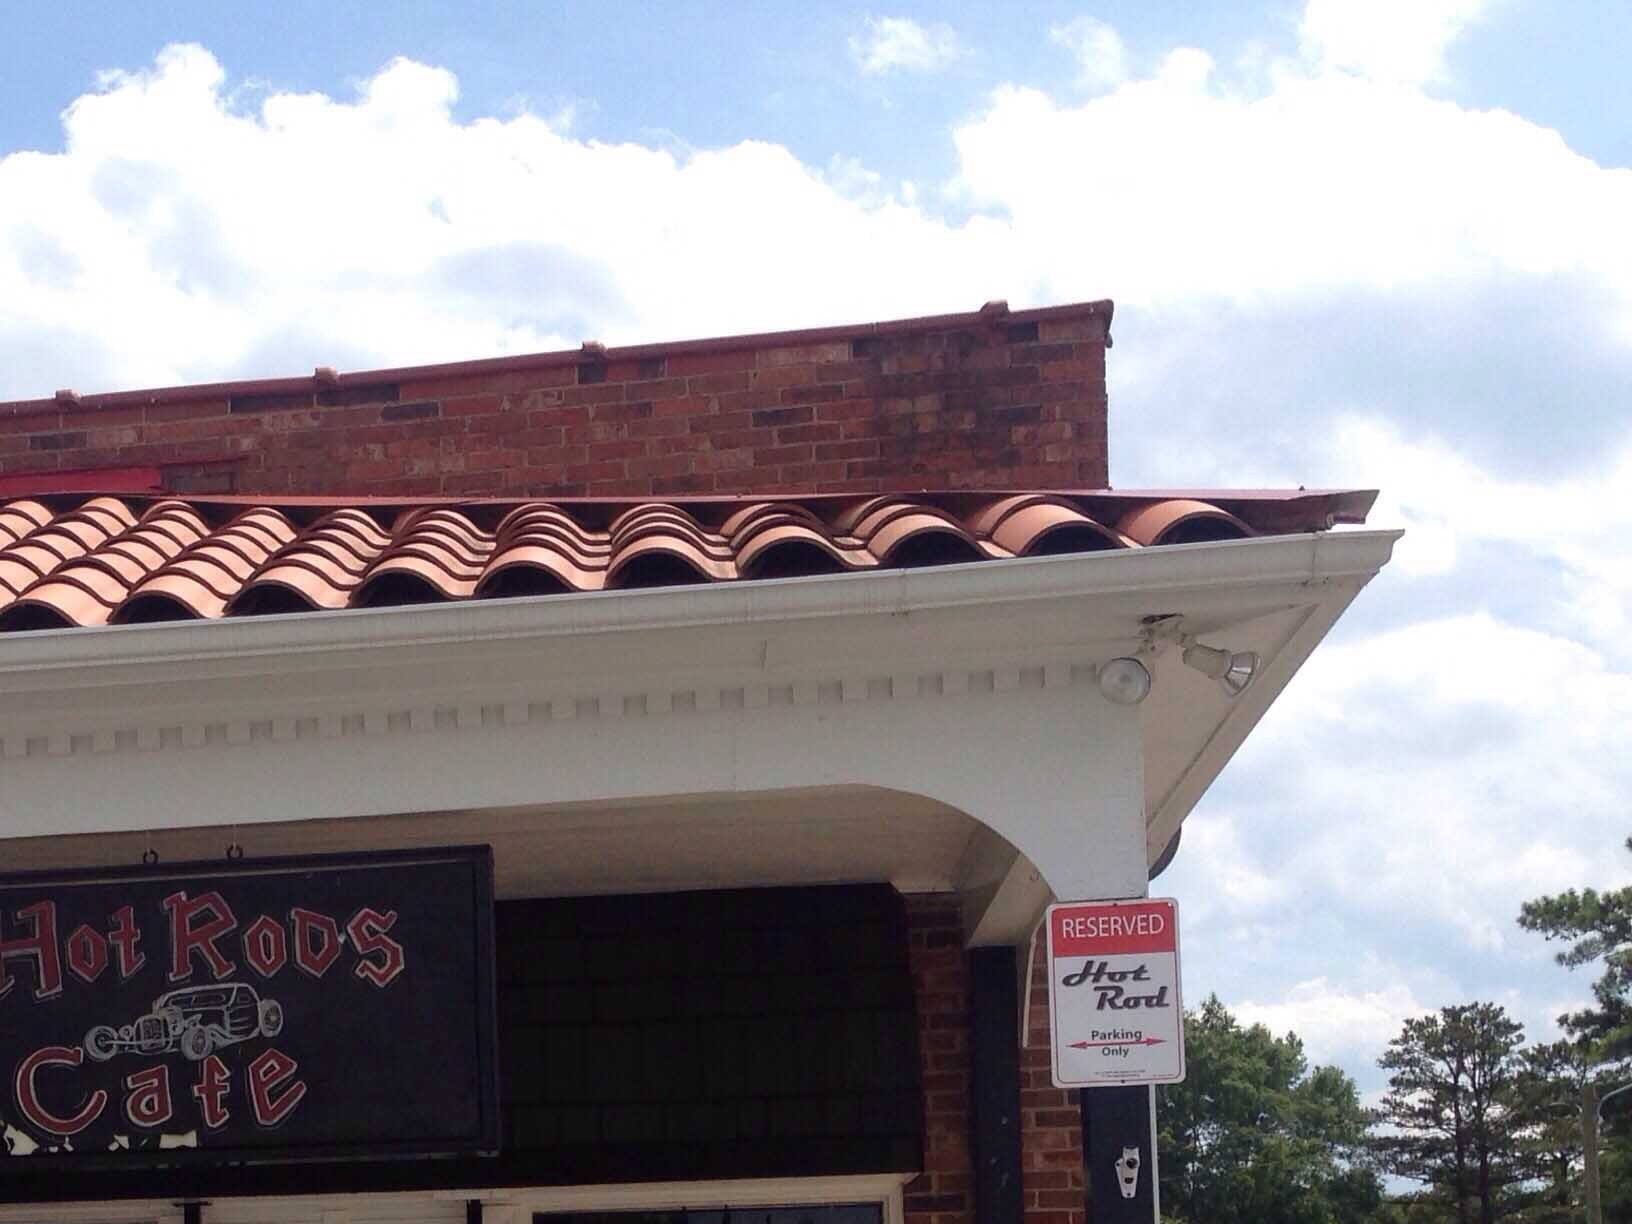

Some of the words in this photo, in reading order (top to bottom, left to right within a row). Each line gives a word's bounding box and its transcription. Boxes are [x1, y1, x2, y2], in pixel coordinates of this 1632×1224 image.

[1062, 913, 1165, 939] RESERVED
[1062, 960, 1152, 987] Hot
[1093, 985, 1171, 1011] Rod
[1090, 1029, 1143, 1042] Parking
[1101, 1046, 1130, 1058] Only
[14, 1046, 307, 1135] Cafe
